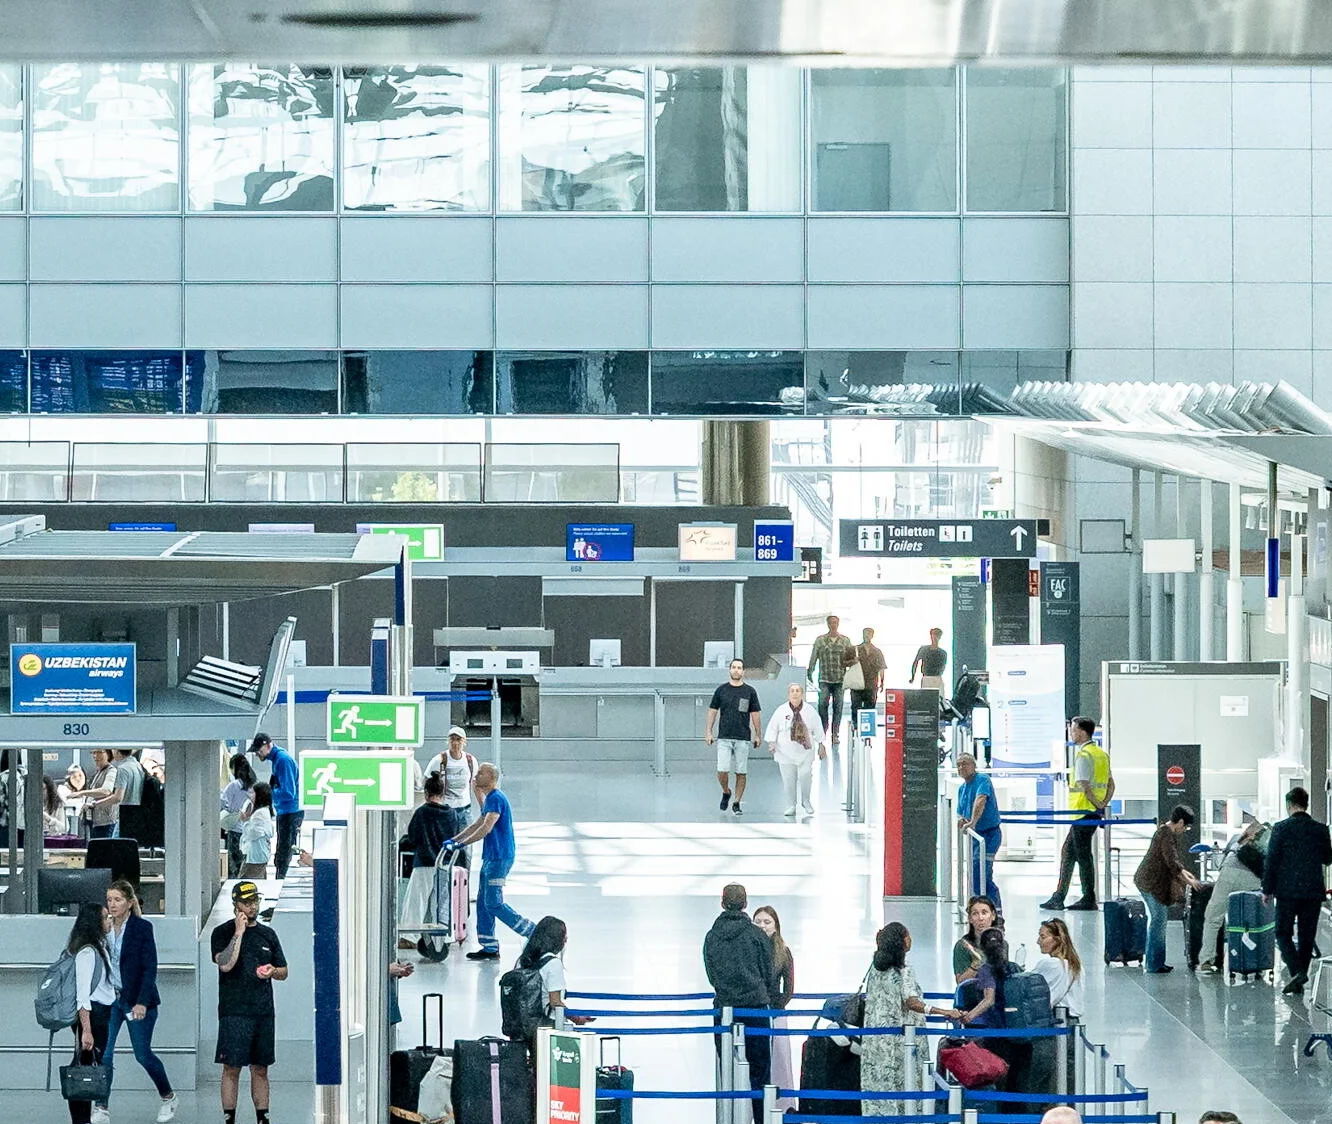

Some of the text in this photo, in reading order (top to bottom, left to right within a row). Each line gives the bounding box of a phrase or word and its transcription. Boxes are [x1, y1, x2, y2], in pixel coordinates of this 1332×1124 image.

[887, 525, 936, 538] Toiletten
[887, 540, 924, 552] Toilets
[757, 549, 778, 560] 869
[44, 656, 128, 669] UZBEKISTAN
[89, 668, 124, 679] airways
[63, 723, 90, 735] 830
